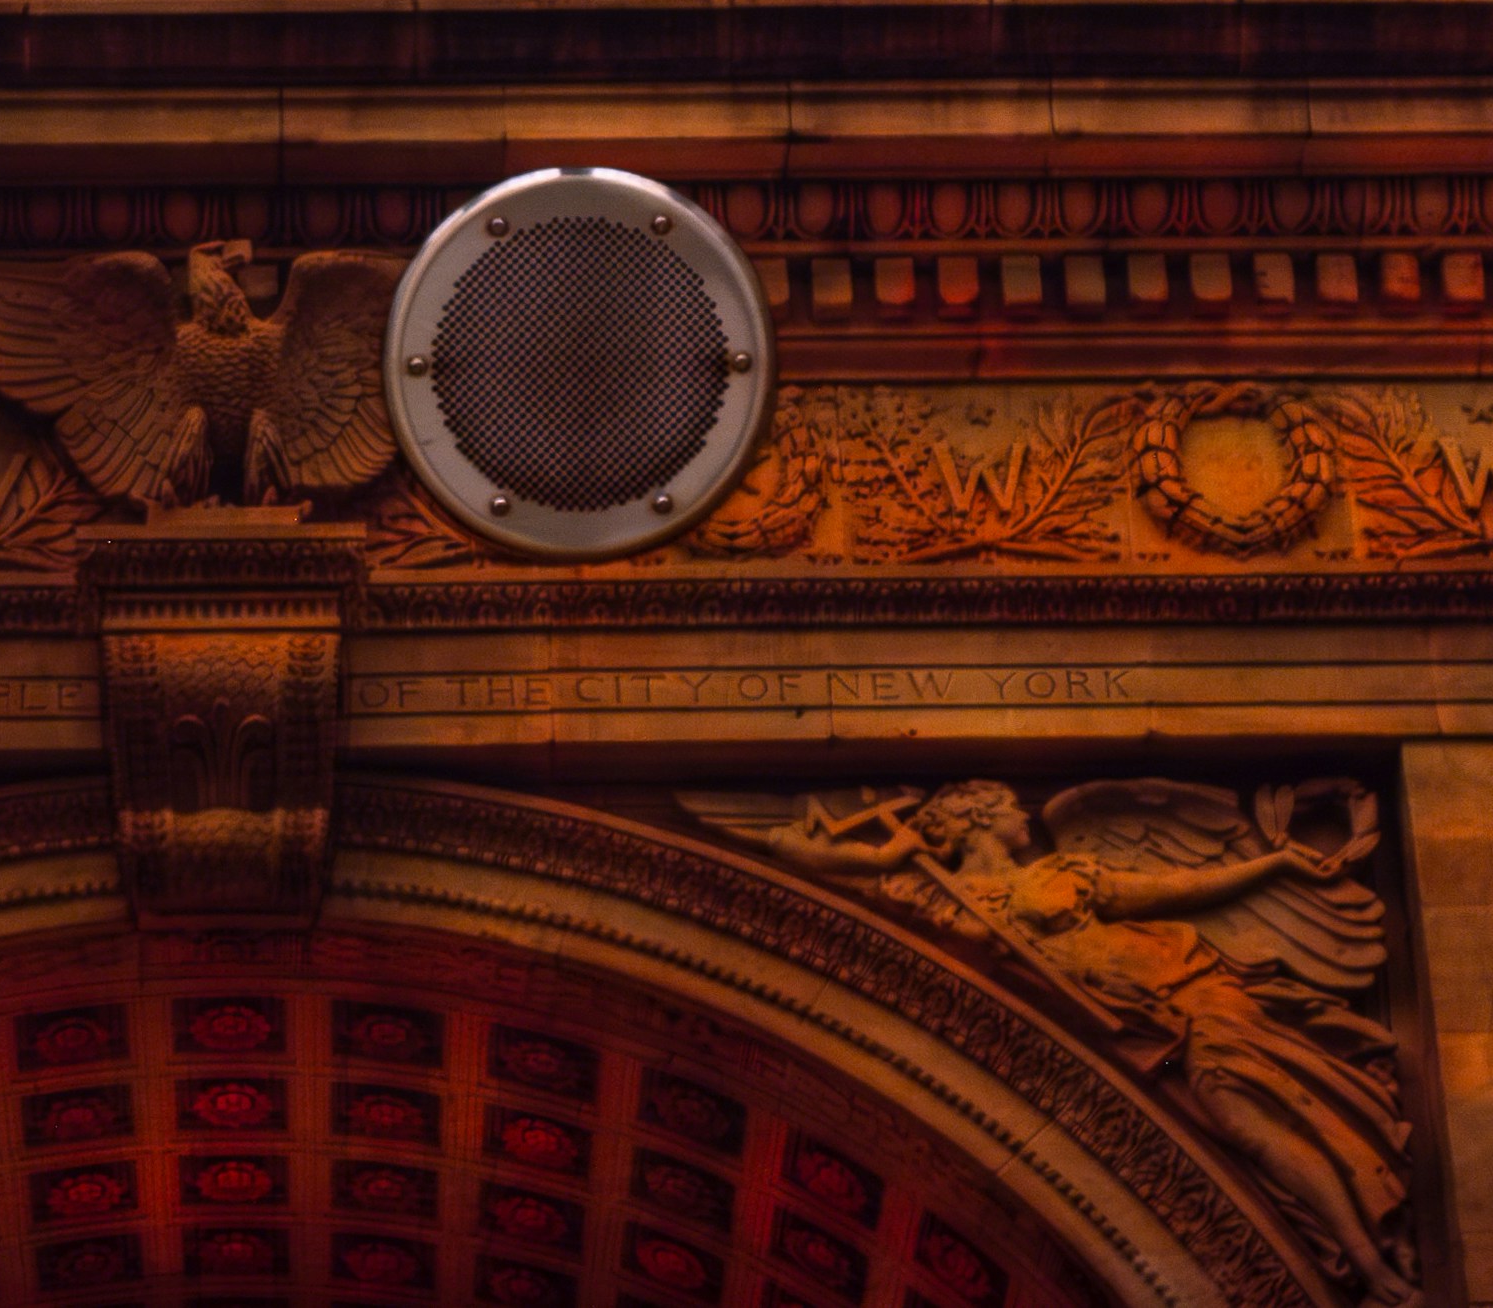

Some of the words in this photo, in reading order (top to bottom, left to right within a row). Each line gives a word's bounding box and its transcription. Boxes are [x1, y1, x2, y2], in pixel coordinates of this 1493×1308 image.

[358, 680, 421, 709] OF
[445, 677, 551, 707] THE
[574, 673, 712, 704] CITY
[736, 672, 801, 702] OF
[826, 671, 953, 701] NEW
[985, 670, 1130, 699] YORK
